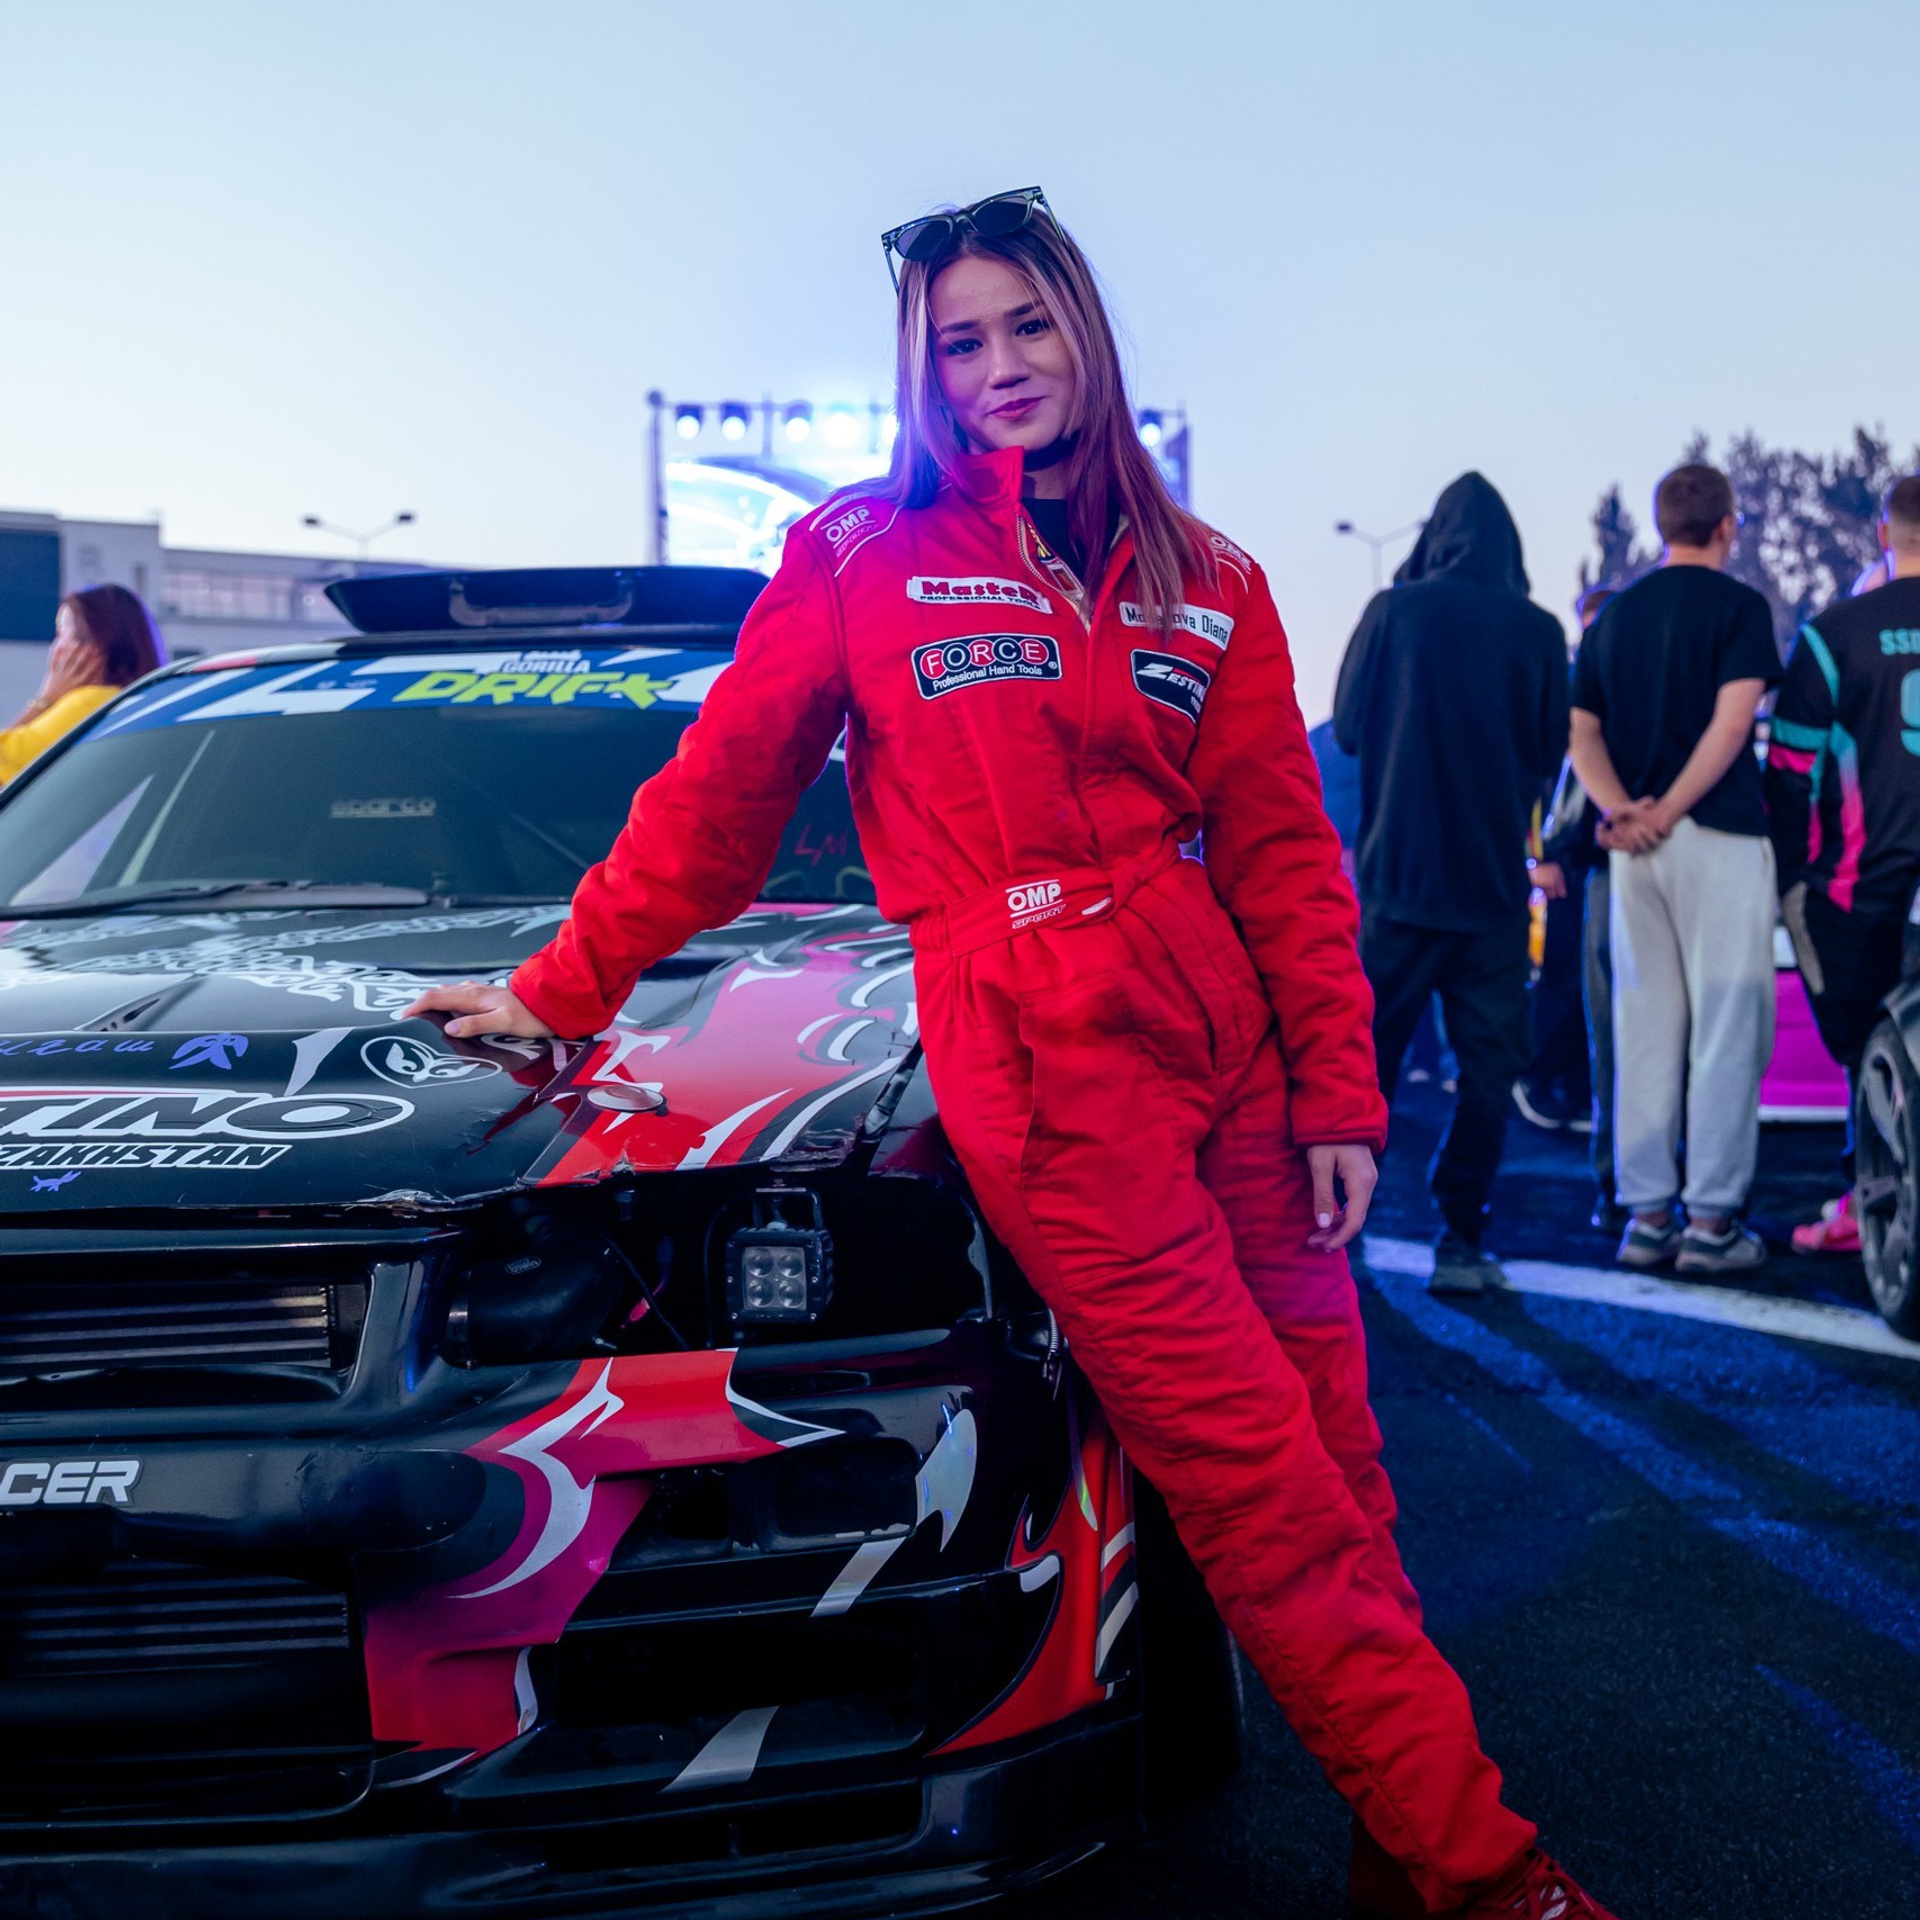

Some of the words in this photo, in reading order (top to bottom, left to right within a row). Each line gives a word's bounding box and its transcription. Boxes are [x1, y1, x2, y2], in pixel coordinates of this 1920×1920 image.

[825, 508, 870, 542] OMP
[1007, 597, 1041, 610] TOOLS
[1202, 615, 1228, 644] Diana
[500, 660, 591, 673] GORILLA
[925, 641, 1043, 676] FORCE
[392, 671, 672, 709] DRIFT
[932, 667, 987, 691] Professional
[989, 661, 1016, 676] Hand
[1017, 663, 1043, 676] Tools
[1136, 663, 1206, 702] ZESTIN
[1007, 883, 1062, 911] OMP
[1012, 904, 1067, 929] SPORT
